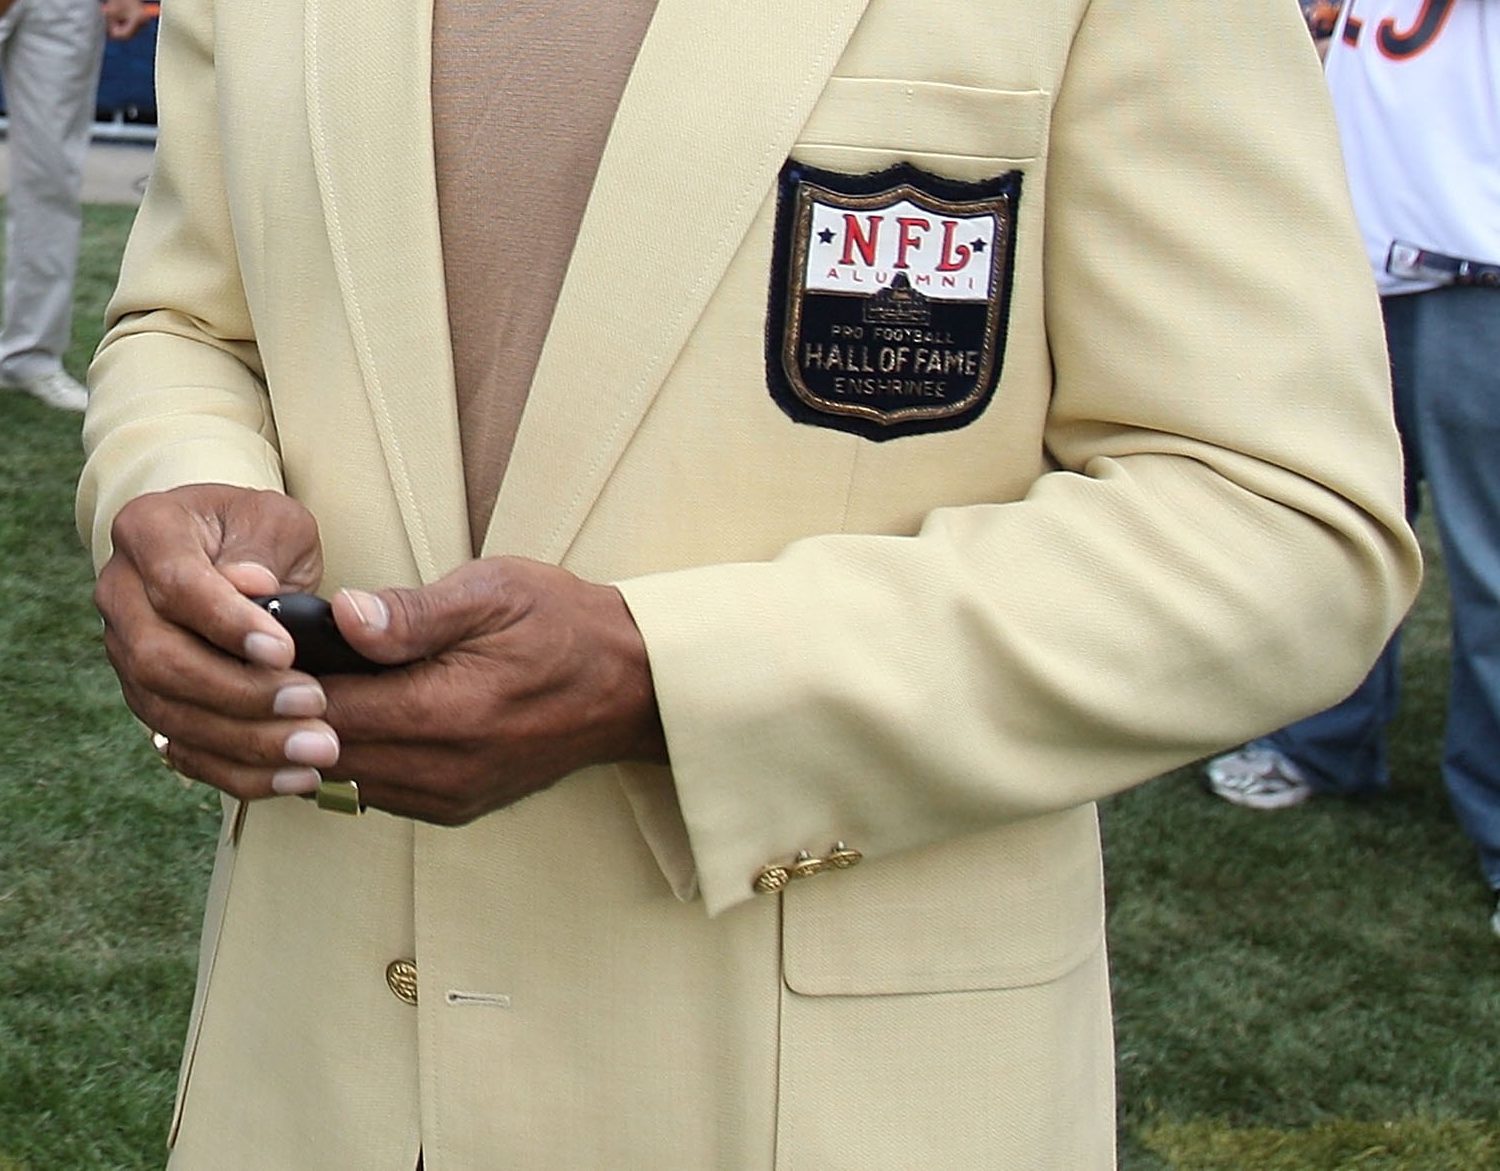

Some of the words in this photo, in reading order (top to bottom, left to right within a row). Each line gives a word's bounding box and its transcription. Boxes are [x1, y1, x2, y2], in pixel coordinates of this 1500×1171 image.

[838, 213, 972, 272] NFL
[826, 267, 975, 289] ALUMNI
[831, 325, 864, 341] PRO
[874, 327, 955, 344] FOOTBALL
[805, 343, 874, 373] HALL
[879, 347, 909, 372] OF
[914, 349, 981, 376] FAME
